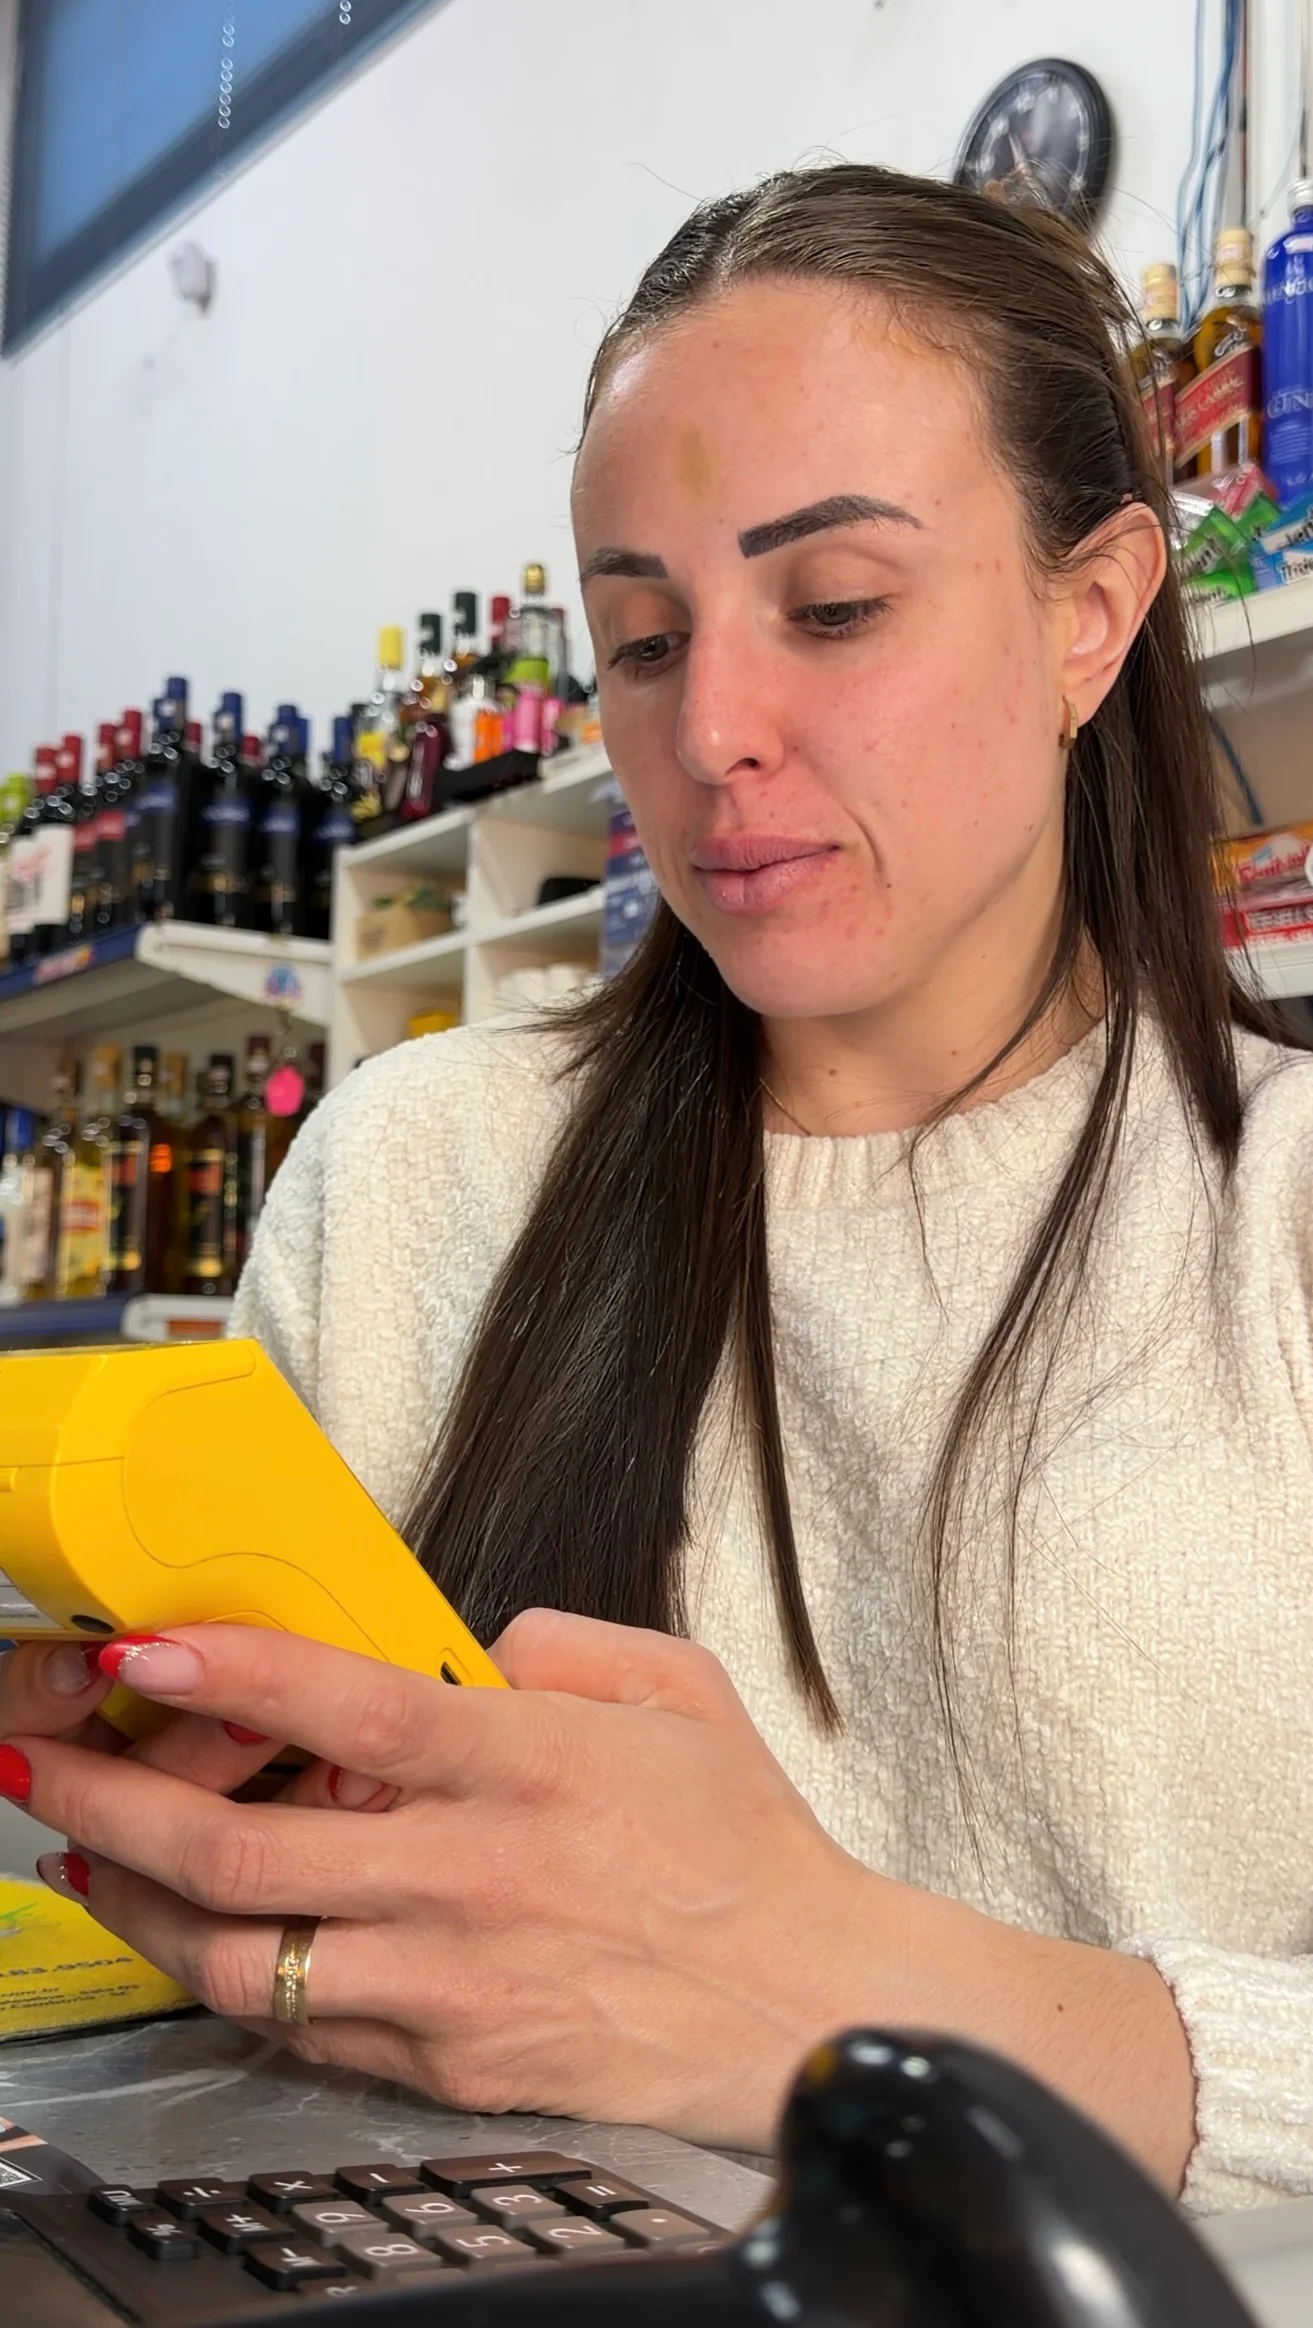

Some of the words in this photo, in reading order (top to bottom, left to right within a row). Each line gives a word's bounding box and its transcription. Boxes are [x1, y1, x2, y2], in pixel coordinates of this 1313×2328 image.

[492, 2192, 543, 2208] 3
[404, 2201, 456, 2216] 6
[314, 2211, 367, 2225] 9
[547, 2224, 604, 2239] 2
[456, 2234, 513, 2249] 5
[363, 2242, 420, 2258] 8
